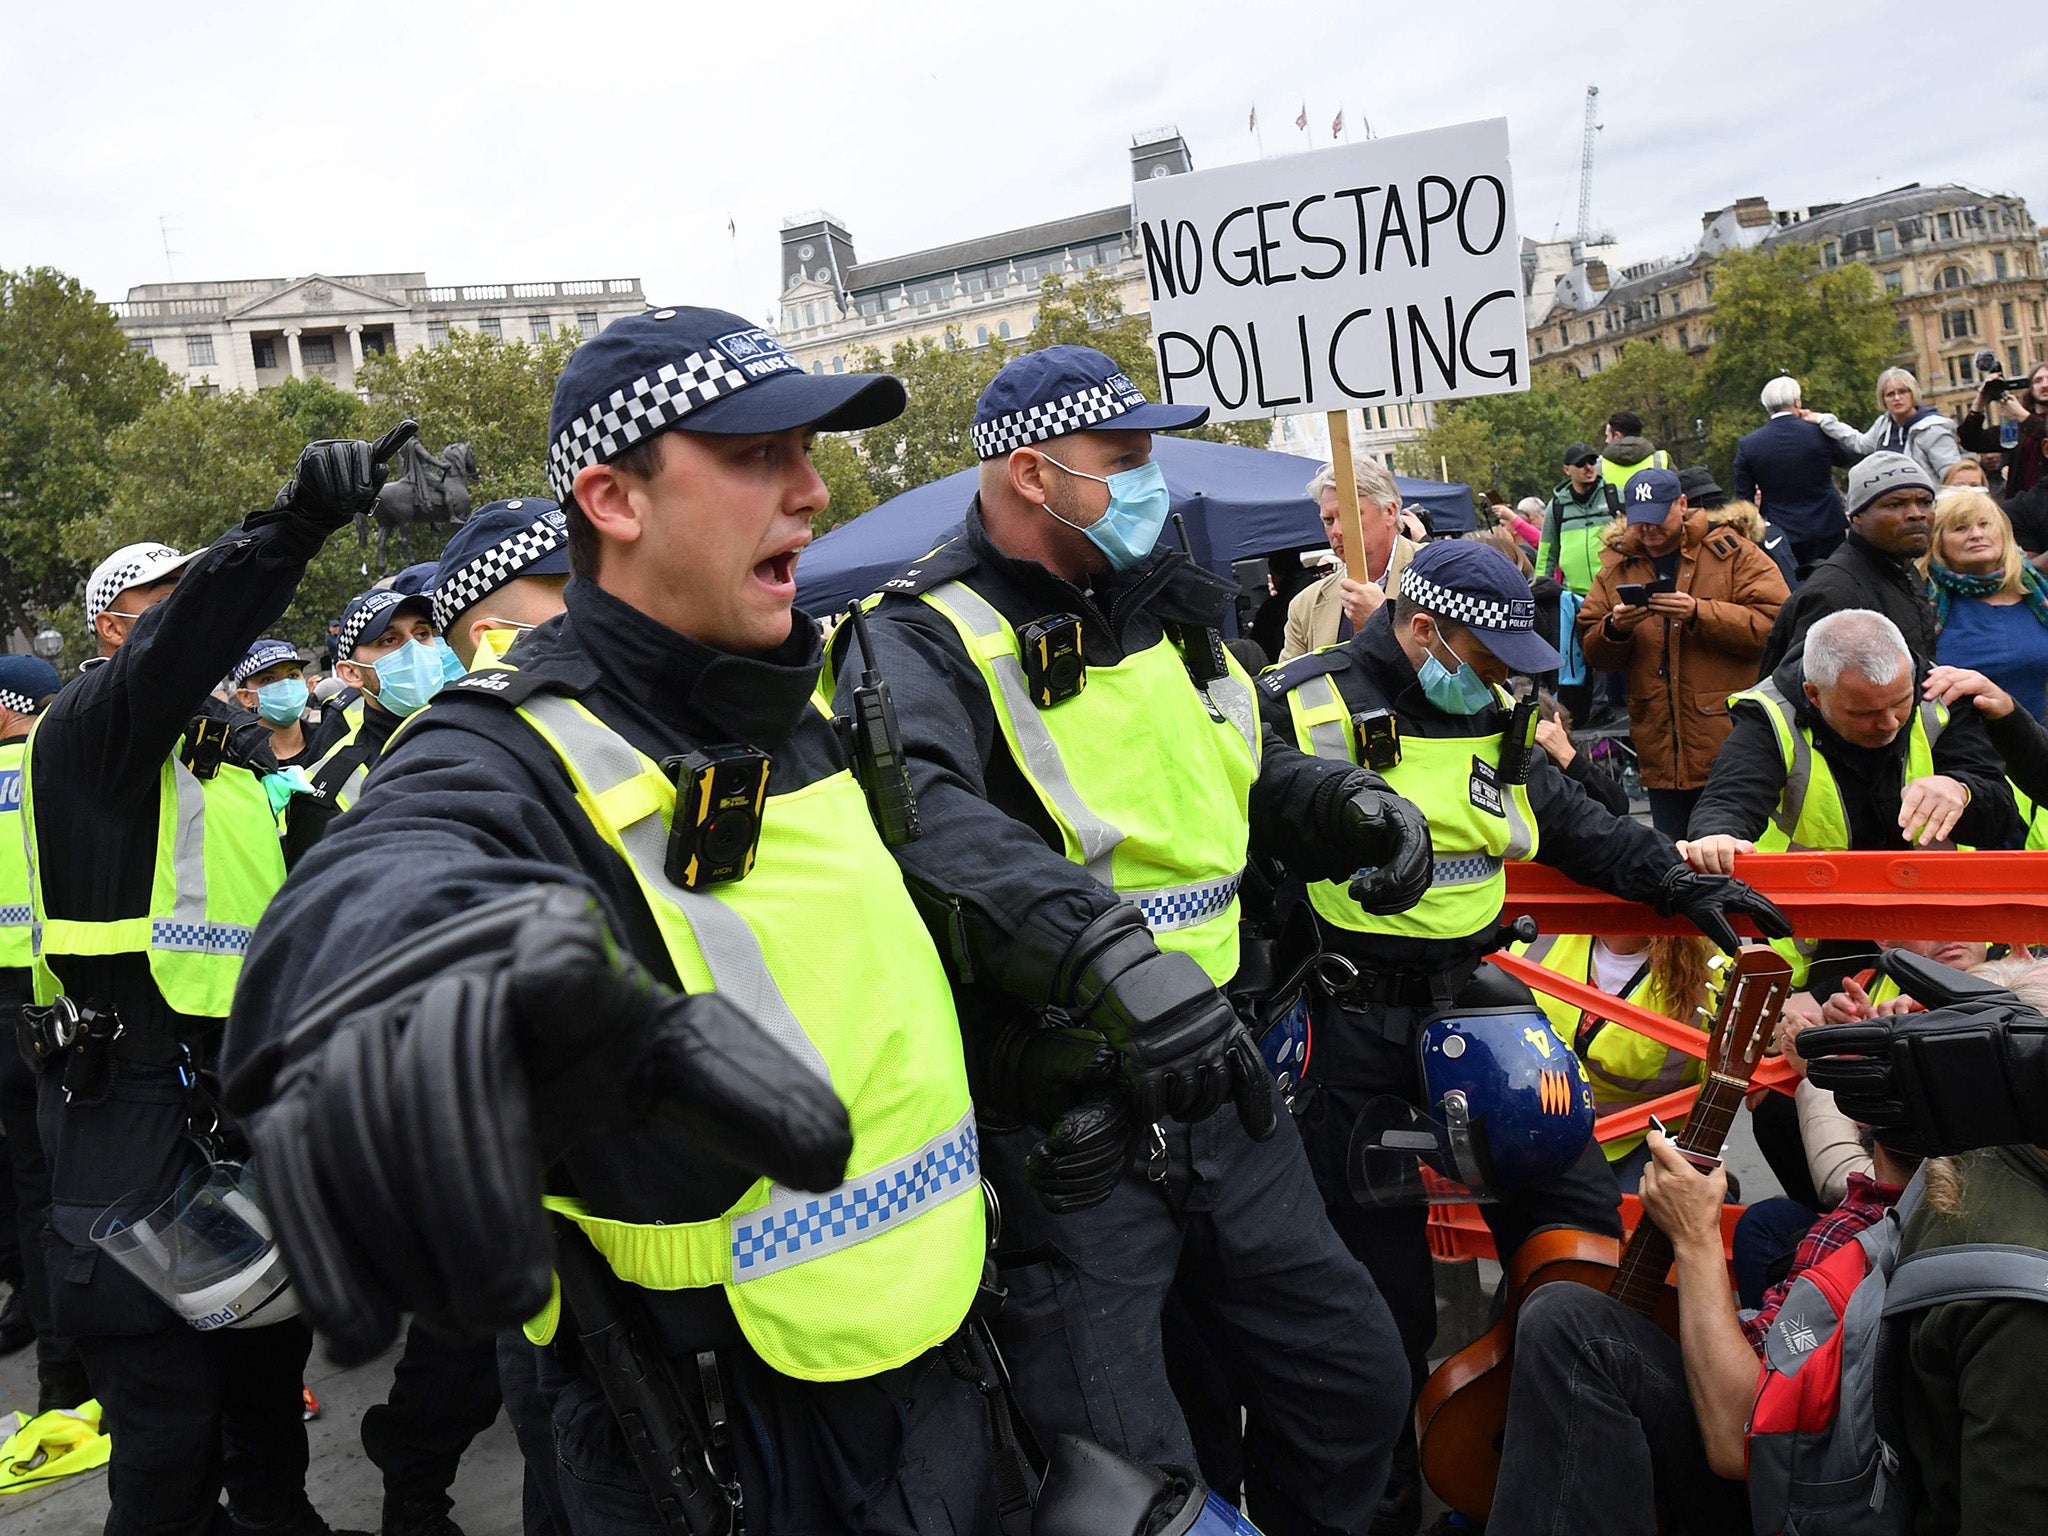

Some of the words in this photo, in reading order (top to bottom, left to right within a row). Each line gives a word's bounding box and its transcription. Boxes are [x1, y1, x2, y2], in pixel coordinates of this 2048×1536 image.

[1141, 218, 1202, 301] NO
[1212, 174, 1506, 287] GESTAPO
[1157, 290, 1516, 410] POLICING
[744, 356, 789, 377] POLICE
[1863, 466, 1918, 488] NYC
[1635, 482, 1653, 502] NY
[1509, 618, 1529, 628] POLICE
[488, 672, 509, 681] U
[1779, 1321, 1798, 1355] karrimor
